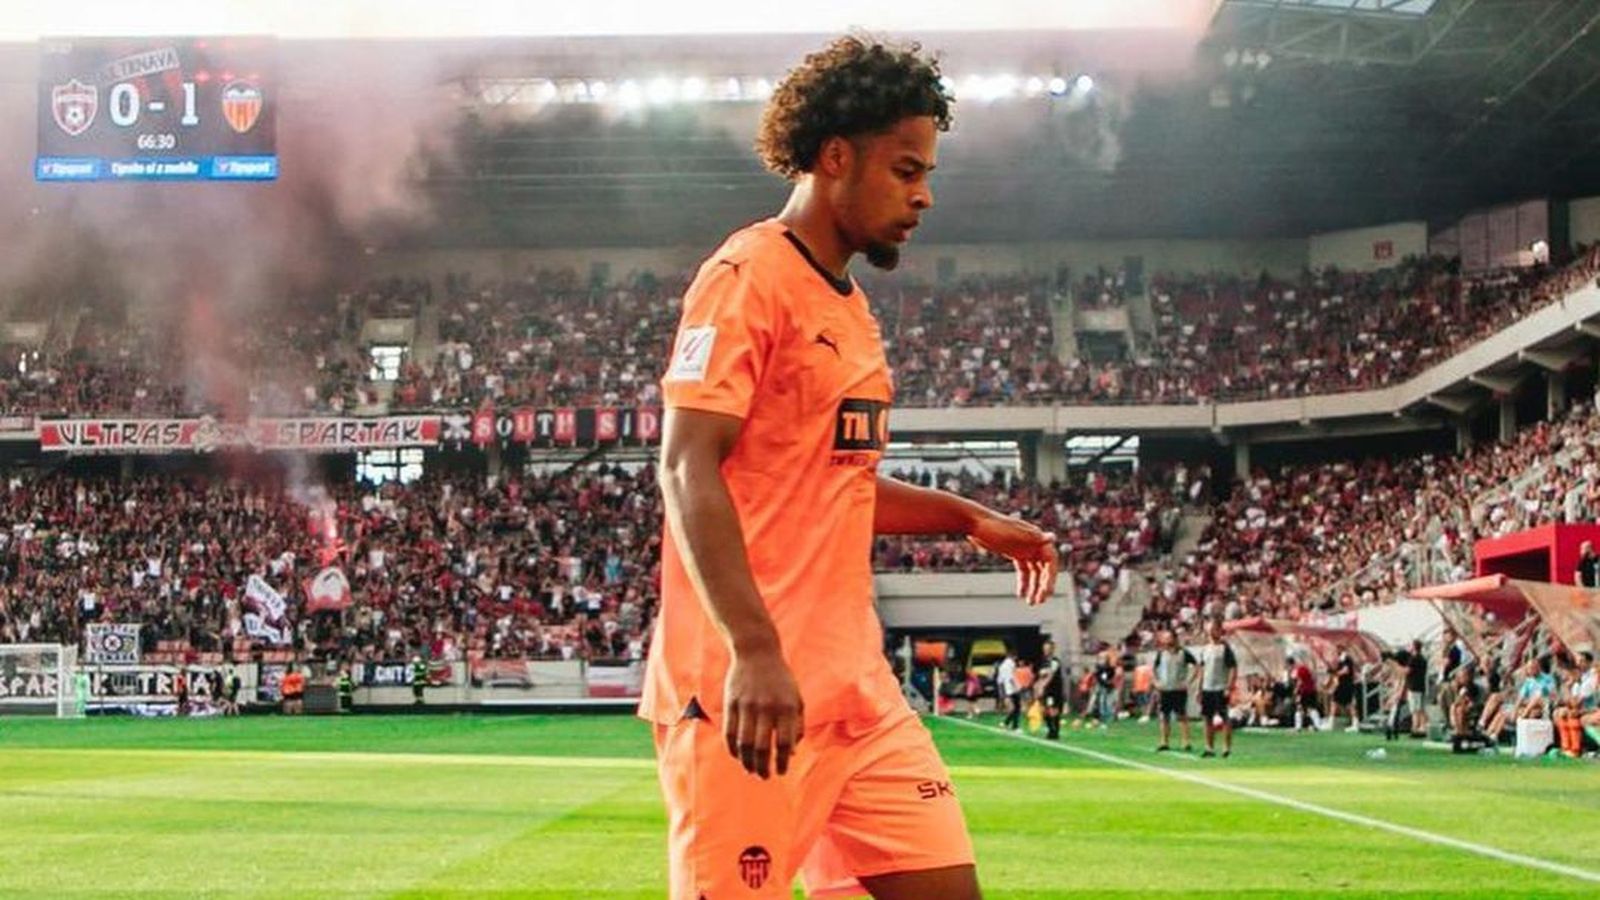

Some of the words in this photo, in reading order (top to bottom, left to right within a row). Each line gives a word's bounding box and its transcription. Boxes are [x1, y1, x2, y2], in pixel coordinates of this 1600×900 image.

[109, 83, 140, 126] 0
[181, 82, 199, 125] 1
[137, 134, 176, 149] 66:30
[59, 421, 181, 446] ULTRAS
[279, 419, 420, 446] SPARTAK
[475, 410, 576, 438] SOUTH
